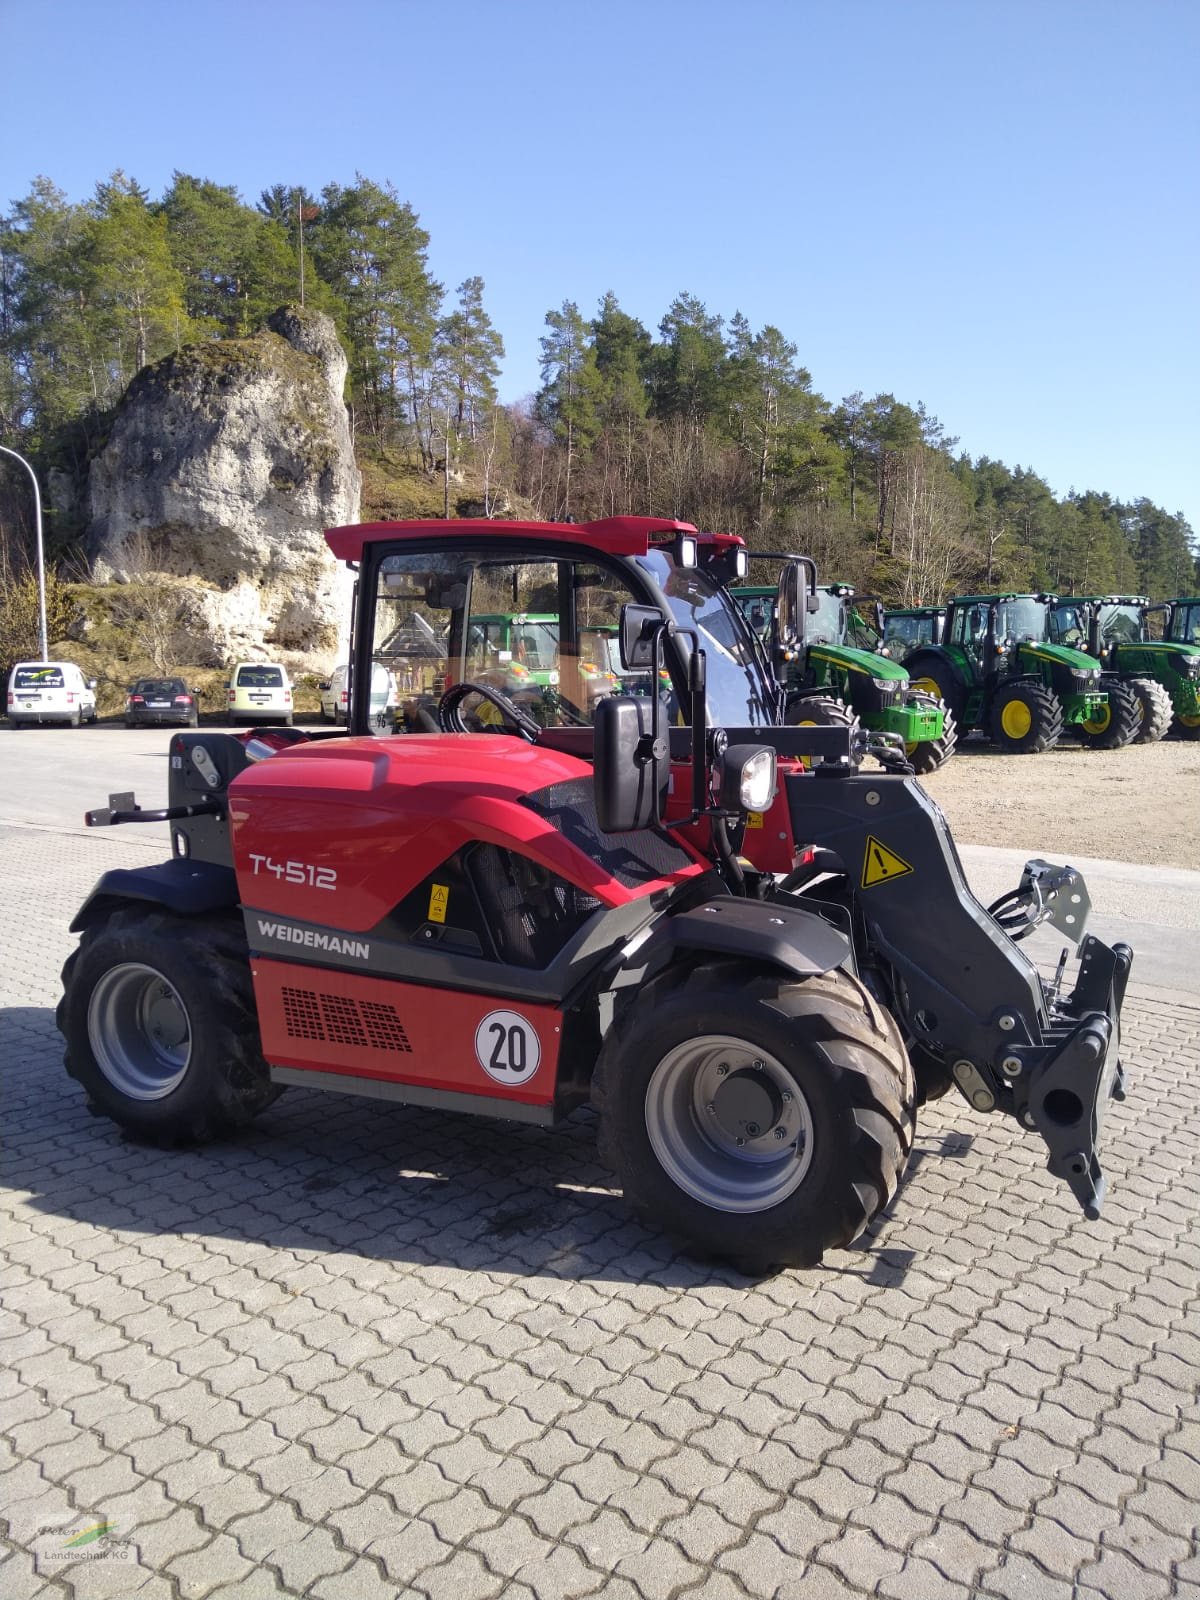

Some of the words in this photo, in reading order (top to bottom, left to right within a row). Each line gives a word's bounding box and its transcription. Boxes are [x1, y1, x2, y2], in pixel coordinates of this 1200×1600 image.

[249, 853, 337, 890] T4512
[257, 920, 370, 959] WEIDEMANN
[489, 1022, 526, 1072] 20
